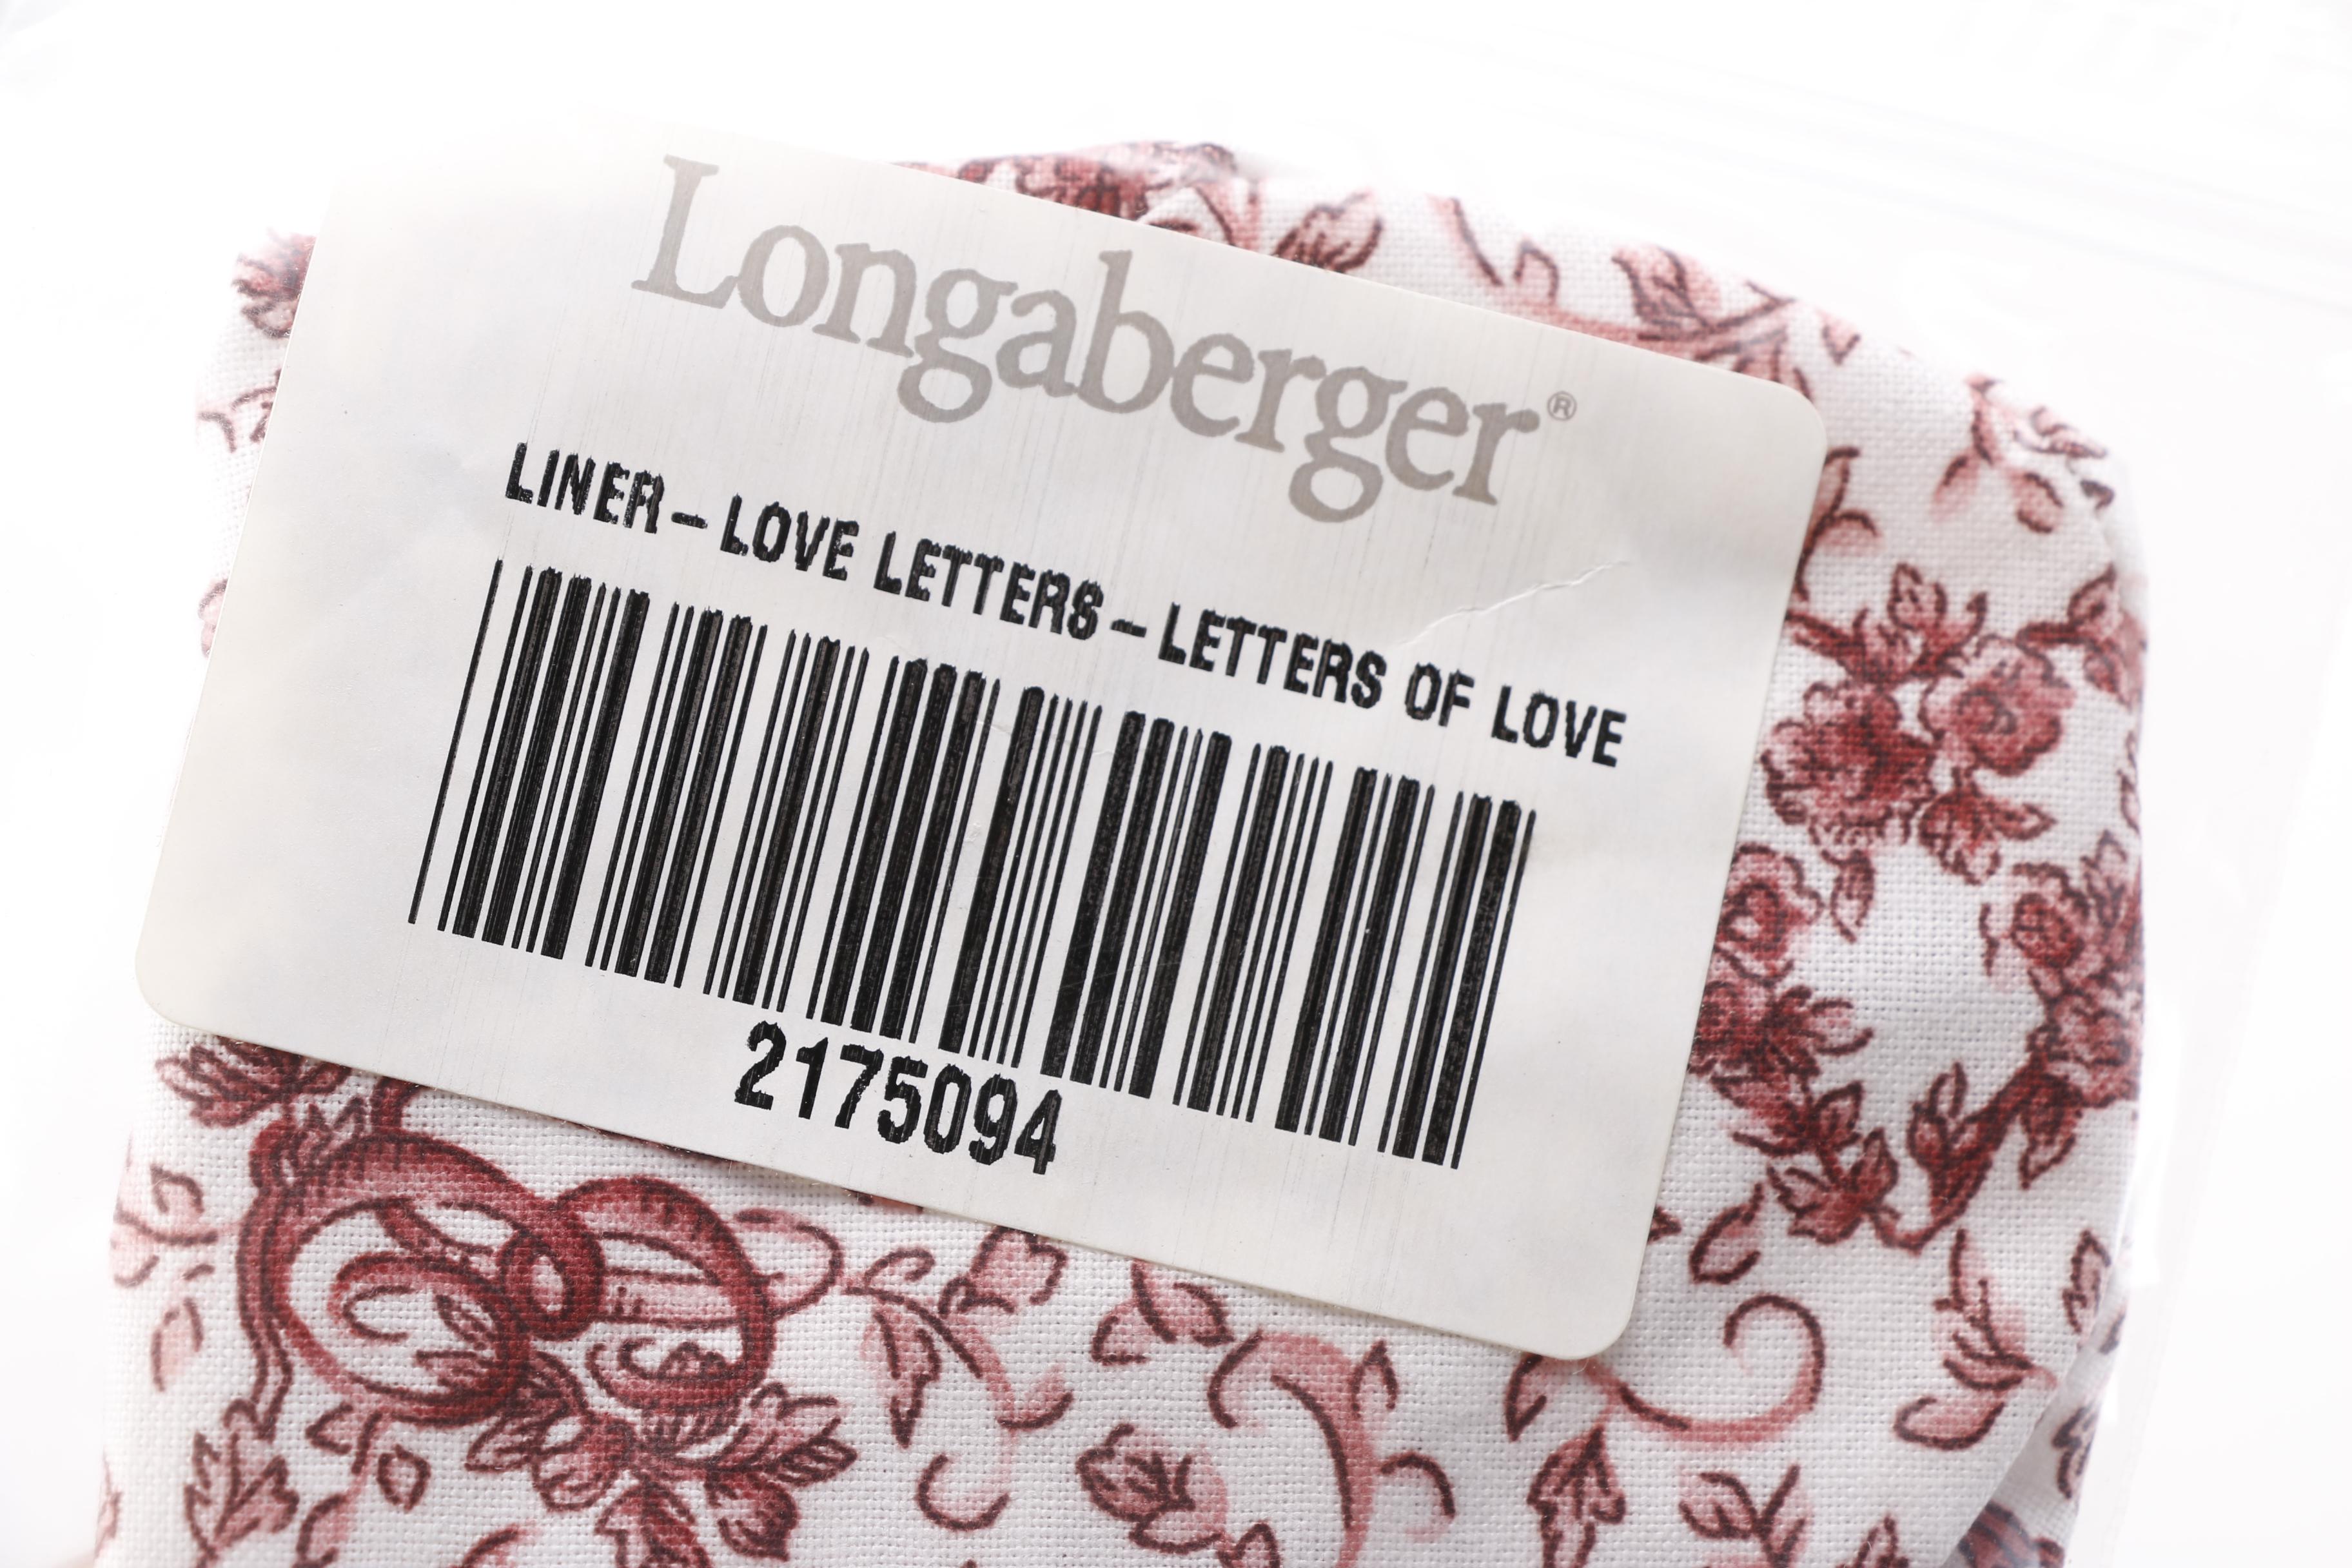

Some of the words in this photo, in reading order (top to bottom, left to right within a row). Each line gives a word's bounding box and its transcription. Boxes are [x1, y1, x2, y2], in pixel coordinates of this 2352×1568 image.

[1405, 664, 1474, 726] OF
[1492, 687, 1625, 767] LOVE
[734, 1021, 1062, 1175] 2175094
